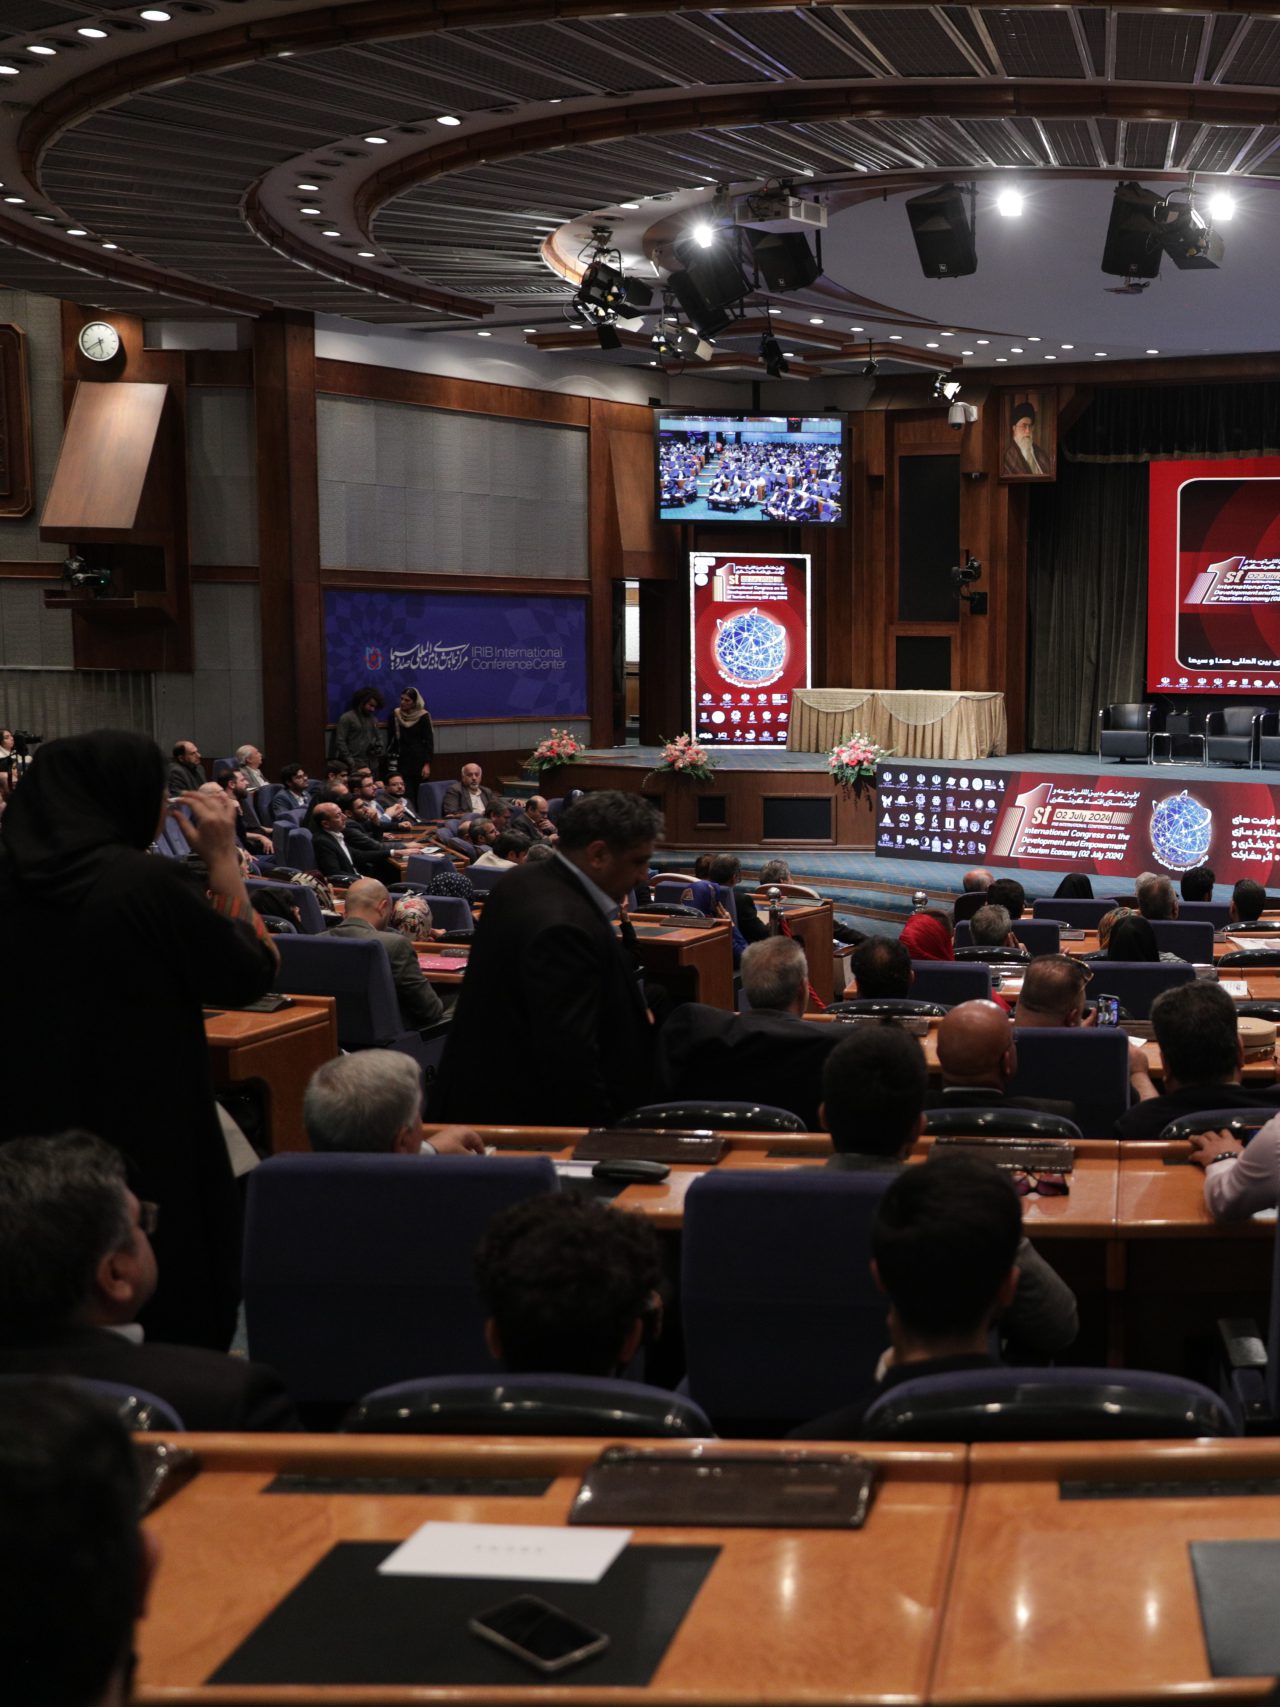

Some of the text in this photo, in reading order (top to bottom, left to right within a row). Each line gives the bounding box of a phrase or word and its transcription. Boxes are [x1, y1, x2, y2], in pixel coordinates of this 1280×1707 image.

[471, 646, 562, 658] IRIB International
[1055, 811, 1111, 822] 02 July 2024
[1231, 815, 1251, 825] های
[1251, 815, 1276, 827] فرصت
[1024, 828, 1069, 837] International
[1070, 830, 1105, 840] Congress
[1117, 833, 1130, 841] the
[1231, 827, 1253, 837] سازی
[1022, 836, 1066, 846] Development
[1079, 840, 1127, 850] Empowerment
[1231, 840, 1237, 849] و
[1238, 838, 1274, 851] گردشگری
[1027, 846, 1050, 855] Tourism
[1050, 848, 1078, 858] Economy
[1078, 850, 1090, 858] (02
[1090, 850, 1104, 861] July
[1231, 850, 1262, 862] مشارکت
